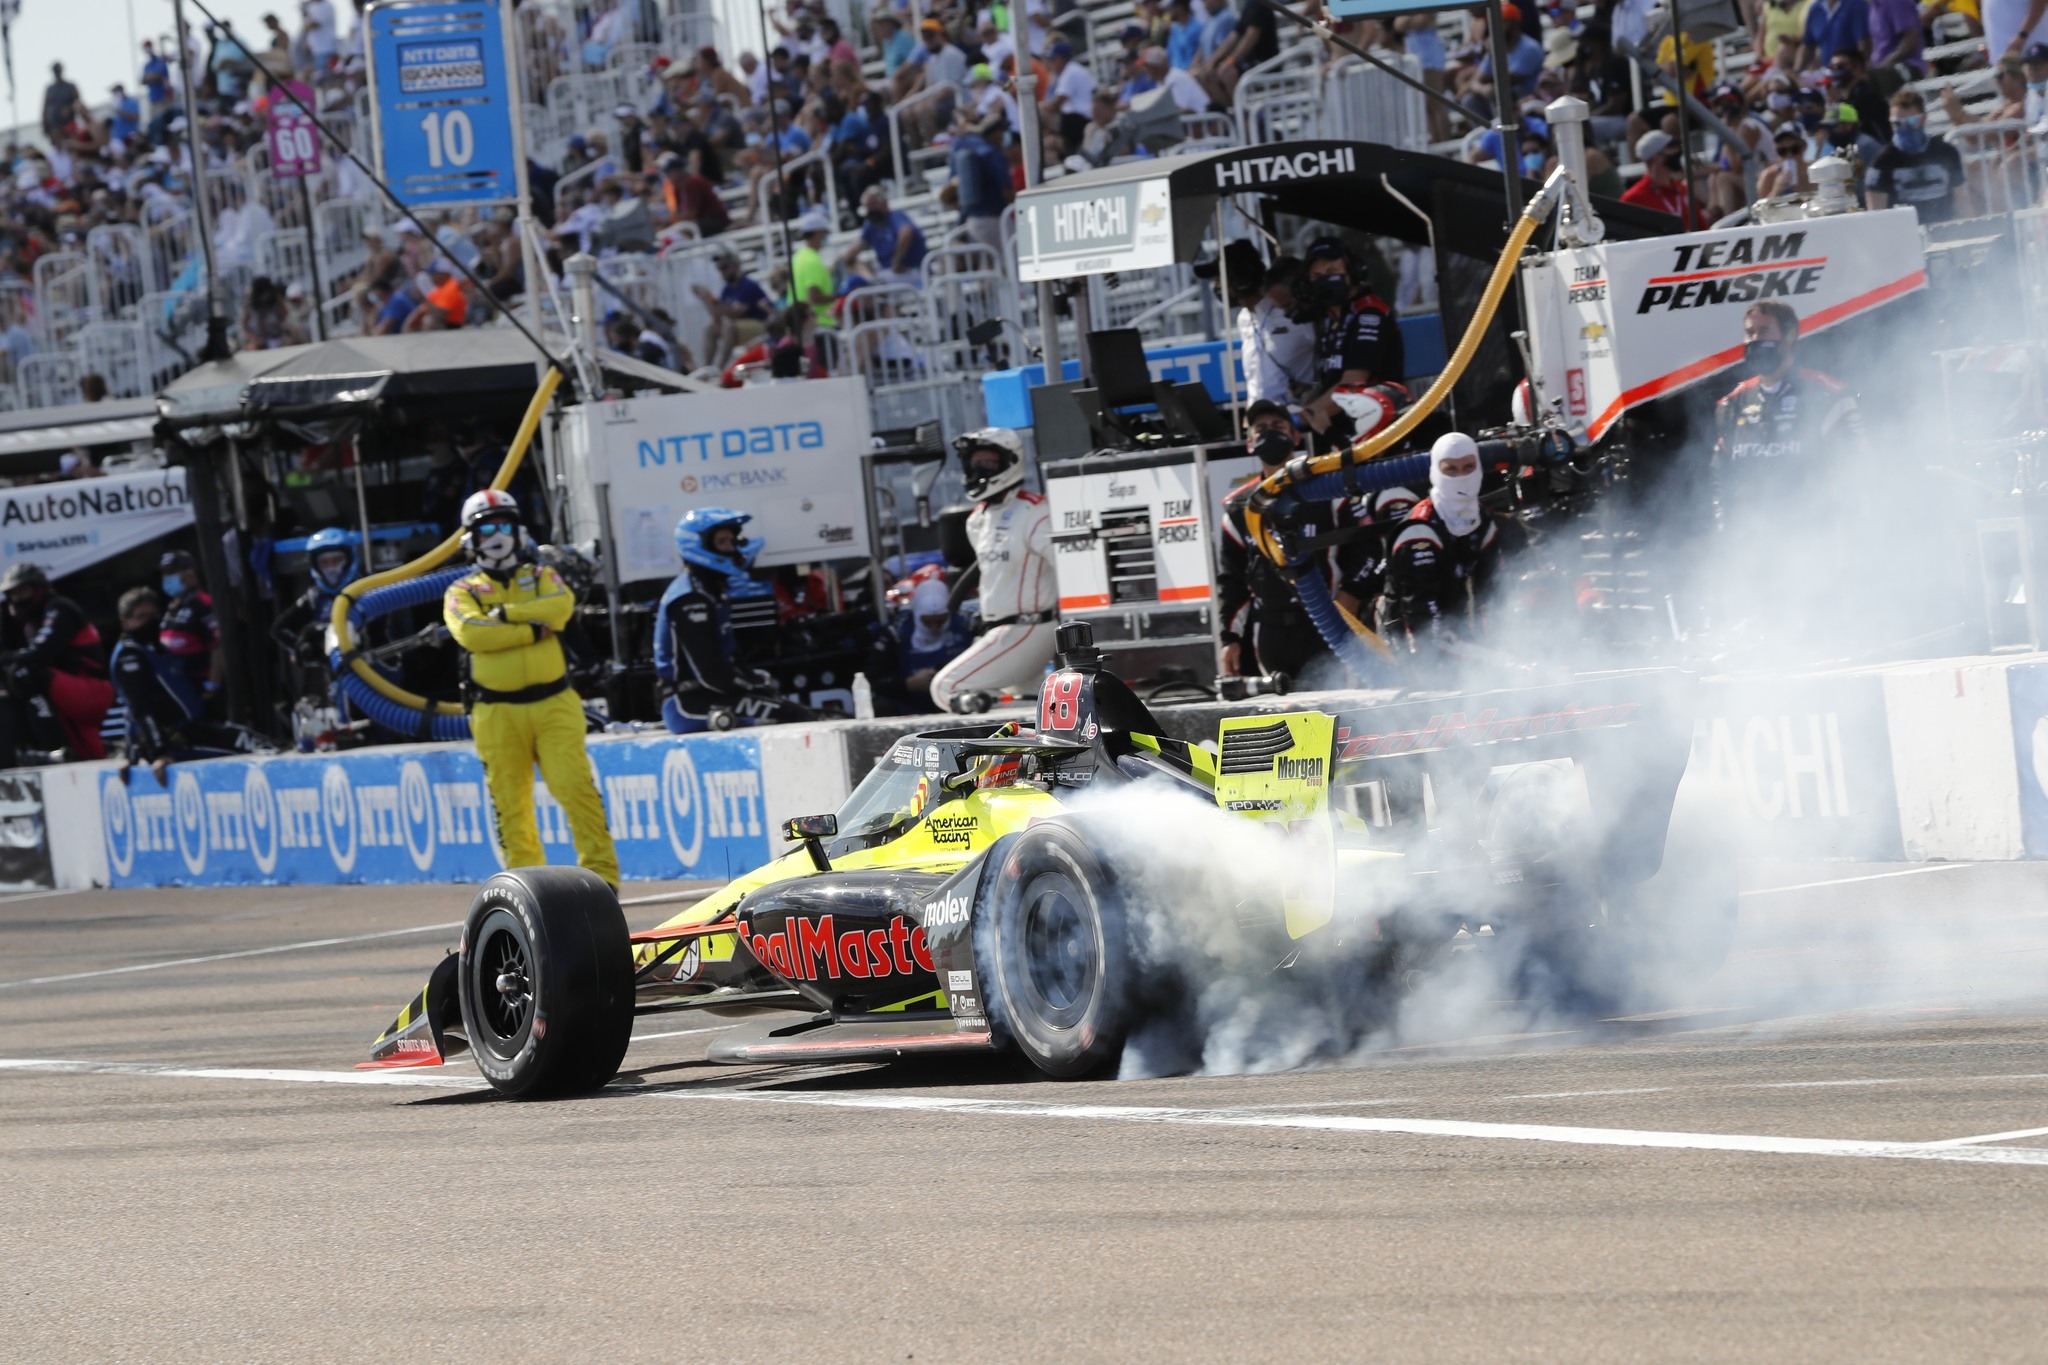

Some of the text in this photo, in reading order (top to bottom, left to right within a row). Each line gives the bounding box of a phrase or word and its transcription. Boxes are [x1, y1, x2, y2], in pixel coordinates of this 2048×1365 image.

[276, 126, 314, 163] 60
[421, 109, 474, 169] 10
[1215, 147, 1356, 188] HITACHI
[1028, 196, 1128, 273] 1 HITACHI
[1673, 230, 1808, 273] TEAM
[1574, 265, 1601, 283] TEAM
[1636, 265, 1826, 315] PENSKE
[1568, 285, 1606, 304] PENSKE
[637, 432, 714, 468] NTT
[2, 484, 185, 527] AutoNation
[1064, 510, 1092, 528] TEAM
[1164, 499, 1192, 519] TEAM
[1158, 524, 1198, 544] PENSKE
[1041, 672, 1084, 731] 18
[1278, 756, 1324, 780] Morgan
[132, 794, 175, 851] NTT
[205, 792, 246, 850] NTT
[275, 788, 322, 848] NTT
[355, 786, 403, 846] NTT
[433, 782, 483, 844] NTT
[605, 774, 661, 840] NTT
[703, 770, 762, 838] NTT
[924, 813, 978, 829] American
[1225, 800, 1254, 811] HPD
[932, 829, 970, 850] Racing
[482, 887, 535, 942] Firestone
[923, 889, 969, 928] molex
[739, 914, 937, 981] SealMaste
[397, 1039, 419, 1052] SCOUTS
